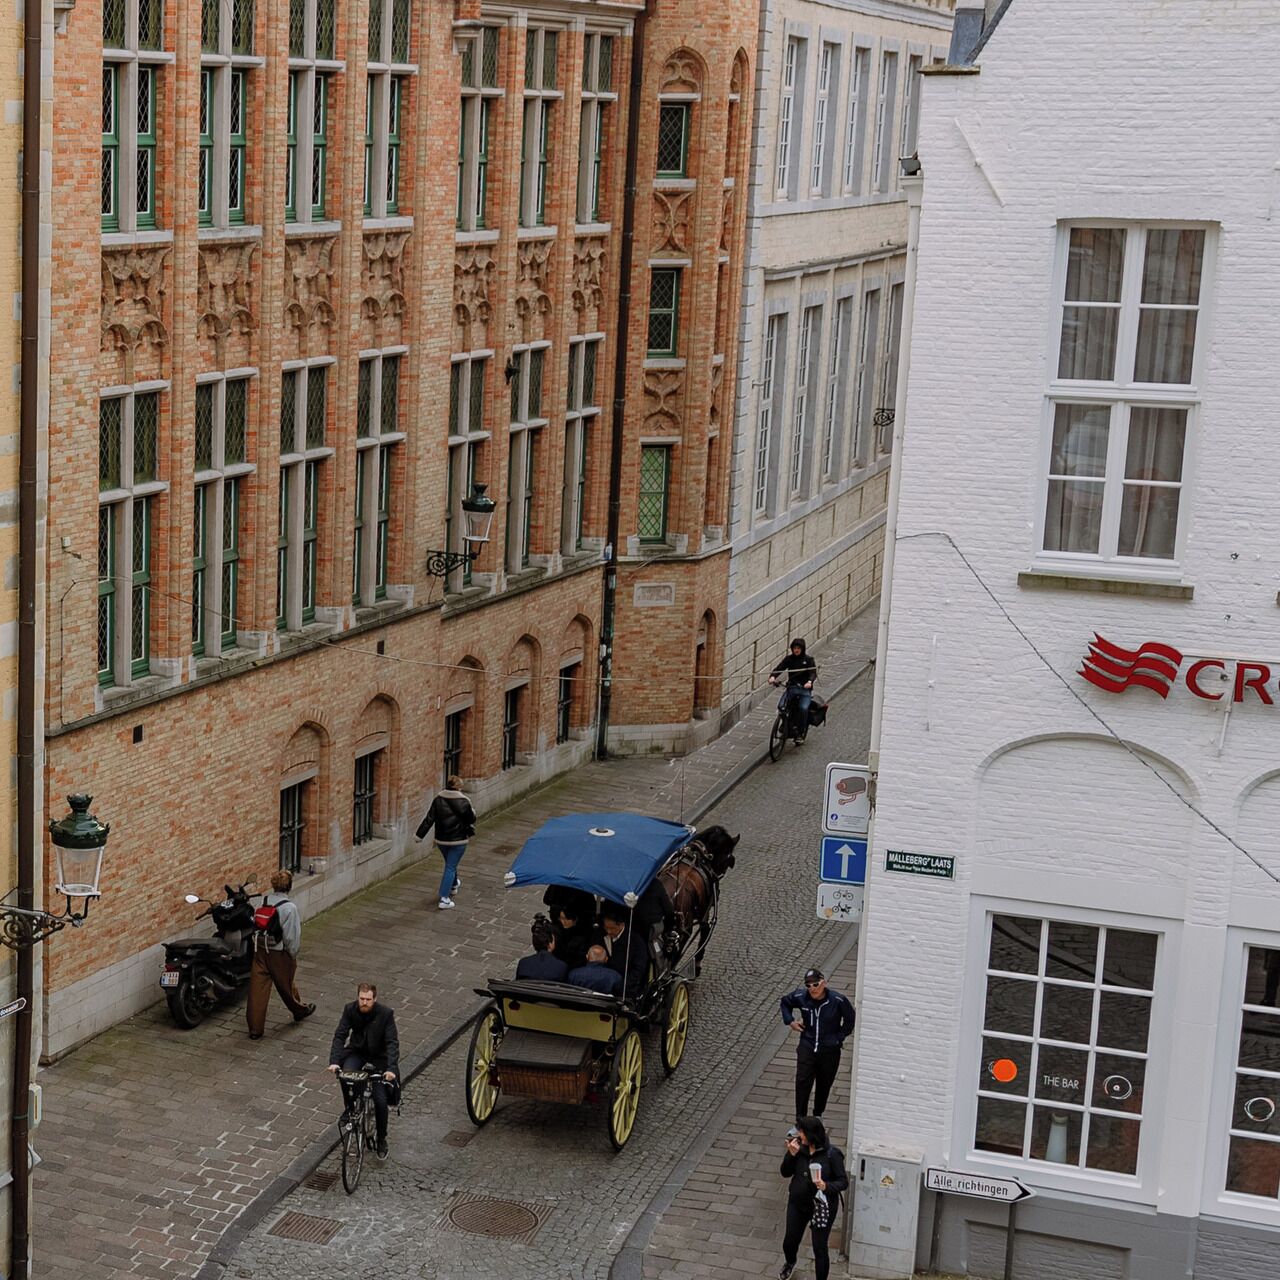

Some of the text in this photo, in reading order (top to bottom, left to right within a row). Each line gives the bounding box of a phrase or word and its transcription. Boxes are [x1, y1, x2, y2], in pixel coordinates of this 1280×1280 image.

[1185, 660, 1280, 705] CR
[1043, 1075, 1080, 1090] THE BAR
[933, 1174, 1009, 1196] Alle richtingen
